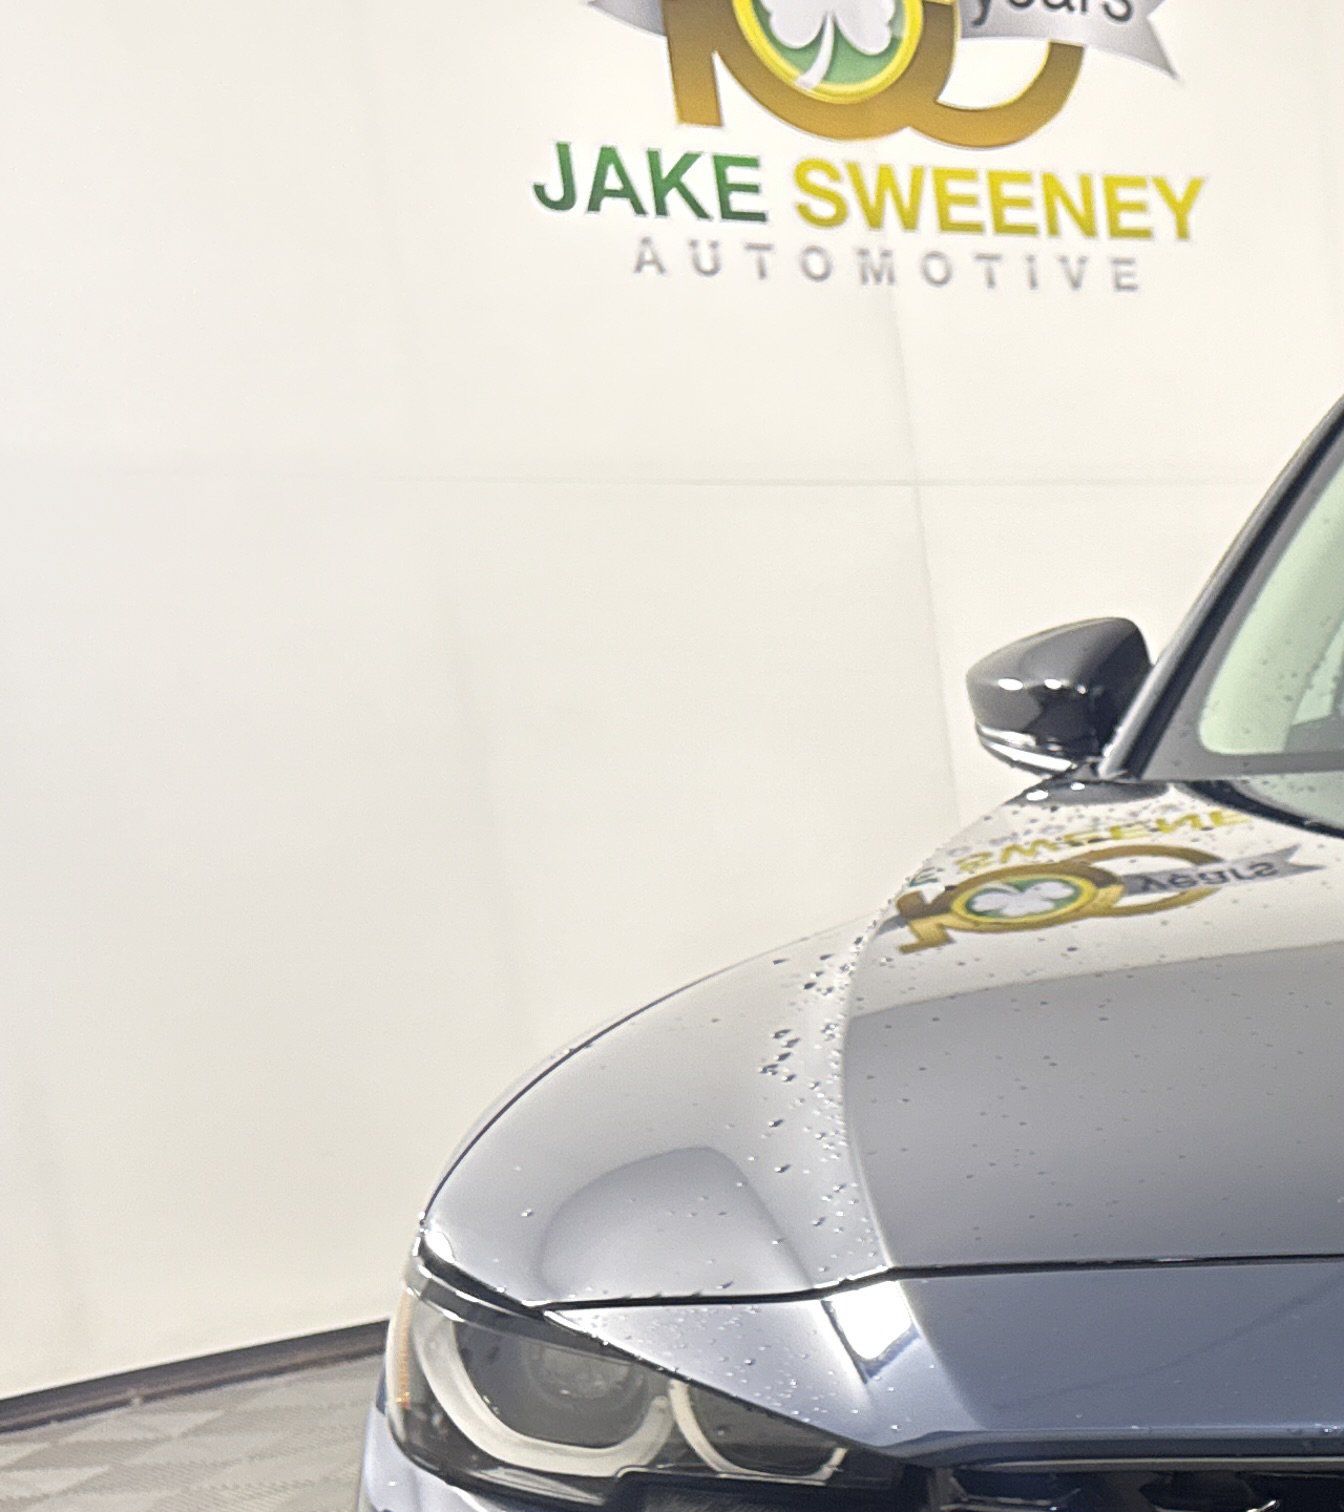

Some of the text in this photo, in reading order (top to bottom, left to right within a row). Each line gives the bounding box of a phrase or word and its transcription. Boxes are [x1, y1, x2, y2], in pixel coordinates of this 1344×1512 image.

[531, 141, 1206, 242] JAKE SWEENEY
[633, 237, 1139, 292] AUTOMOTIVE
